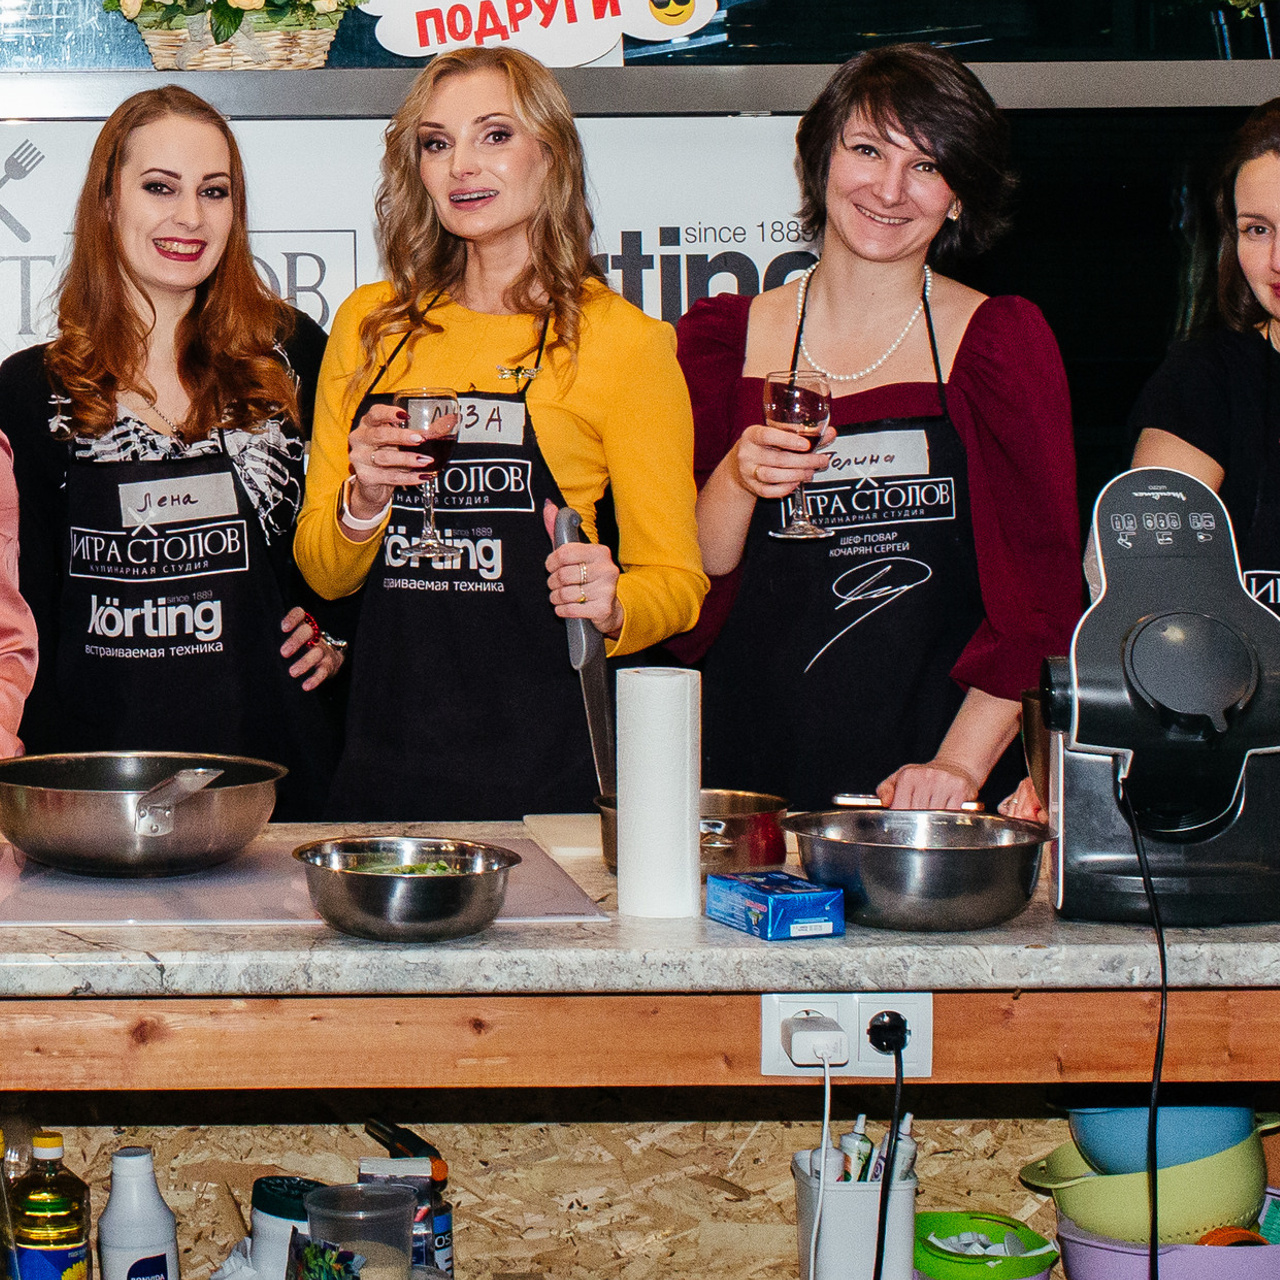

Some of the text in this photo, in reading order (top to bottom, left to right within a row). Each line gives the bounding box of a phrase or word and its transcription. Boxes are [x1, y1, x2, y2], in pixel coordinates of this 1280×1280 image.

[684, 221, 747, 243] since
[137, 492, 198, 512] Лена
[444, 495, 490, 505] СТУДИЯ
[852, 483, 950, 511] СТОЛОВ
[812, 509, 925, 525] КУЛИНАРНАЯ СТУДИЯ
[471, 527, 493, 537] 1889
[840, 531, 898, 545] ШЕФ-ПОВАР
[73, 527, 241, 564] ИГРА СТОЛОВ
[384, 525, 502, 580] örting
[829, 541, 910, 557] КОЧАРЯН СЕРГЕЙ
[90, 560, 209, 575] КУЛИНАРНАЯ СТУДИЯ
[453, 580, 505, 592] техника
[167, 590, 213, 604] since 1889
[87, 594, 222, 642] körting
[85, 641, 224, 658] встраиваемая техника
